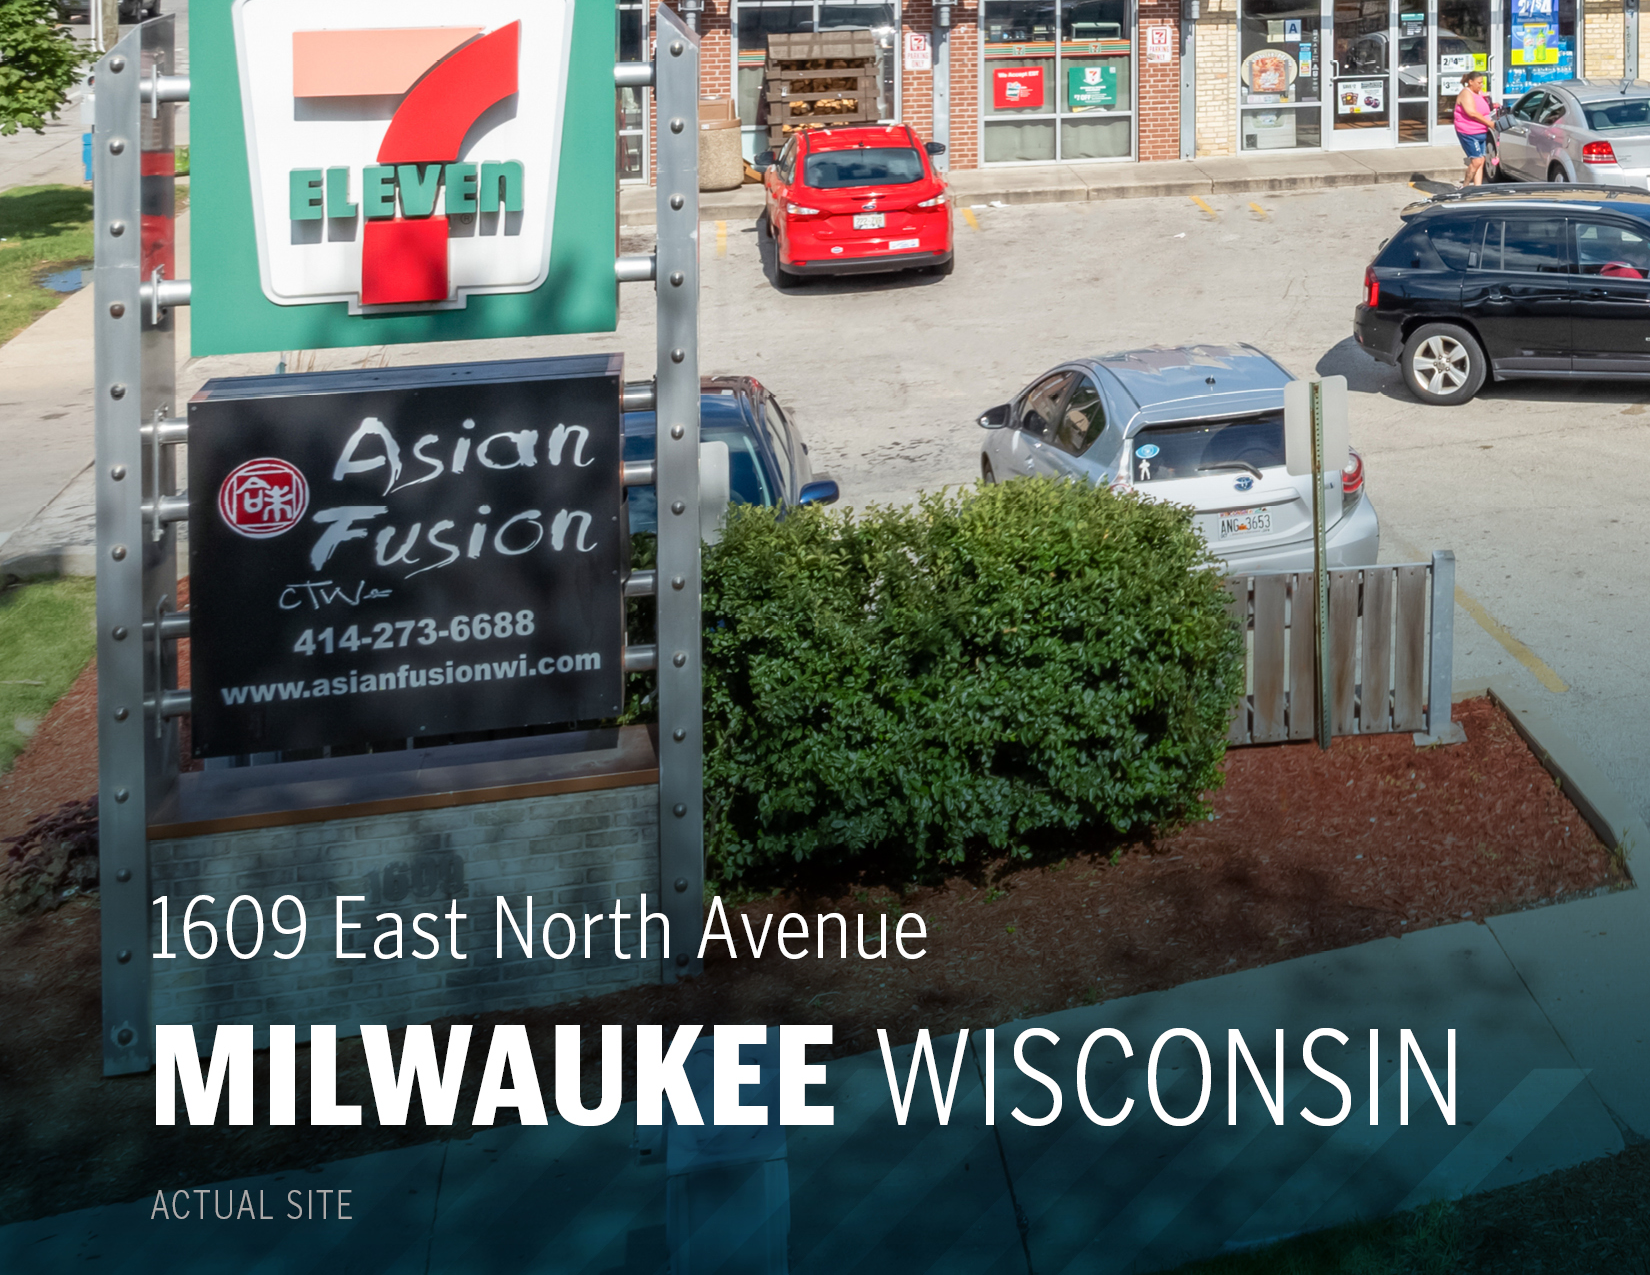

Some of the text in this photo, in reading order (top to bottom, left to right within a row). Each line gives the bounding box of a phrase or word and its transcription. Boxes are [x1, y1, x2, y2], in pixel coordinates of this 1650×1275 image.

[1289, 24, 1297, 34] A
[332, 417, 595, 496] Asian
[310, 504, 598, 579] Fusion
[293, 610, 535, 656] 414-273-6688
[221, 651, 601, 706] www.asianfusionwi.com
